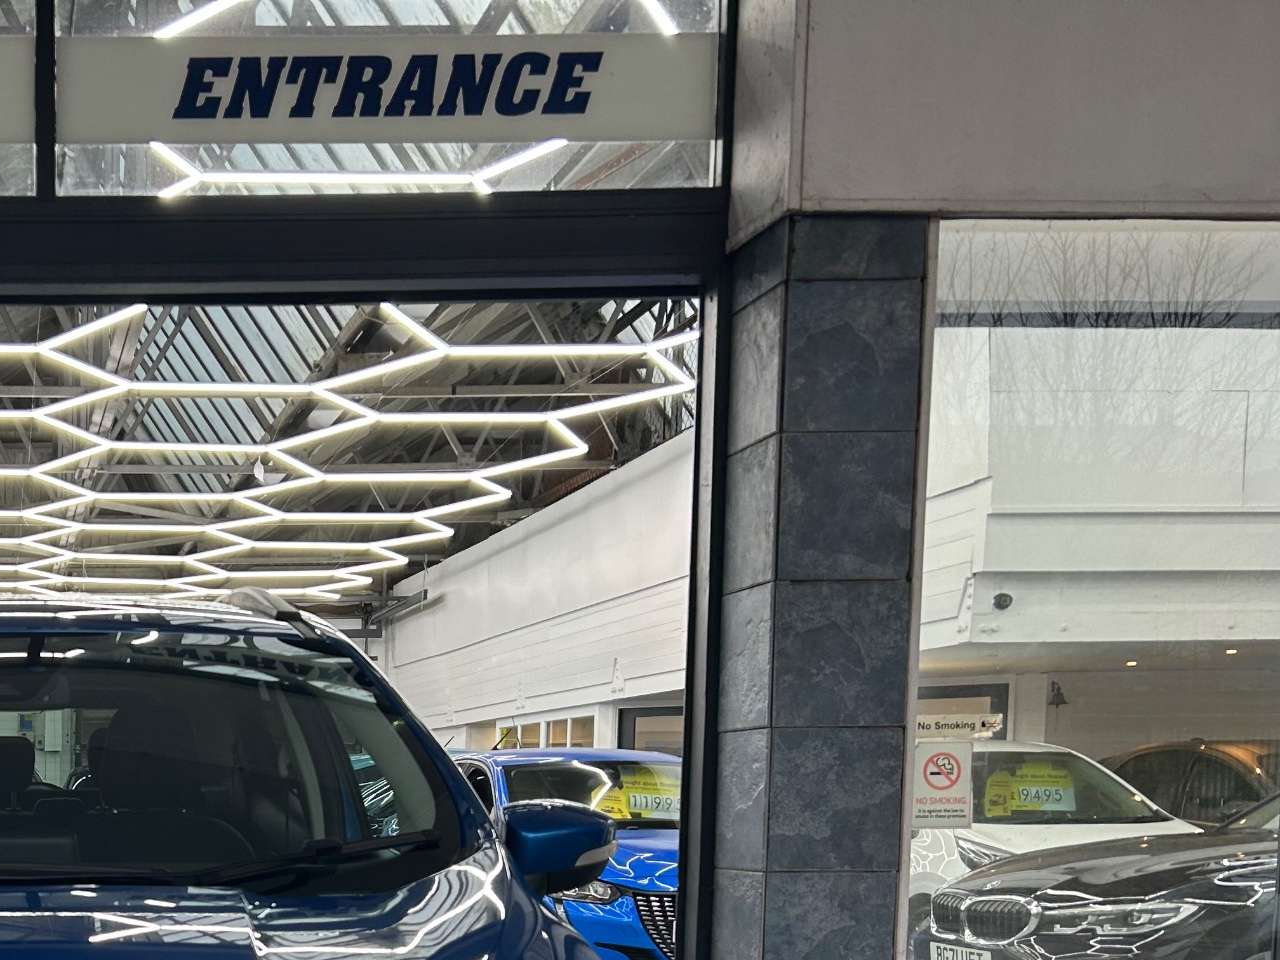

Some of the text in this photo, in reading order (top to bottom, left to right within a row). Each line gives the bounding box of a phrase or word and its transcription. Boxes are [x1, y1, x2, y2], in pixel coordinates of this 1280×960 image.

[172, 51, 604, 119] ENTRANCE
[917, 720, 976, 731] No Smoking
